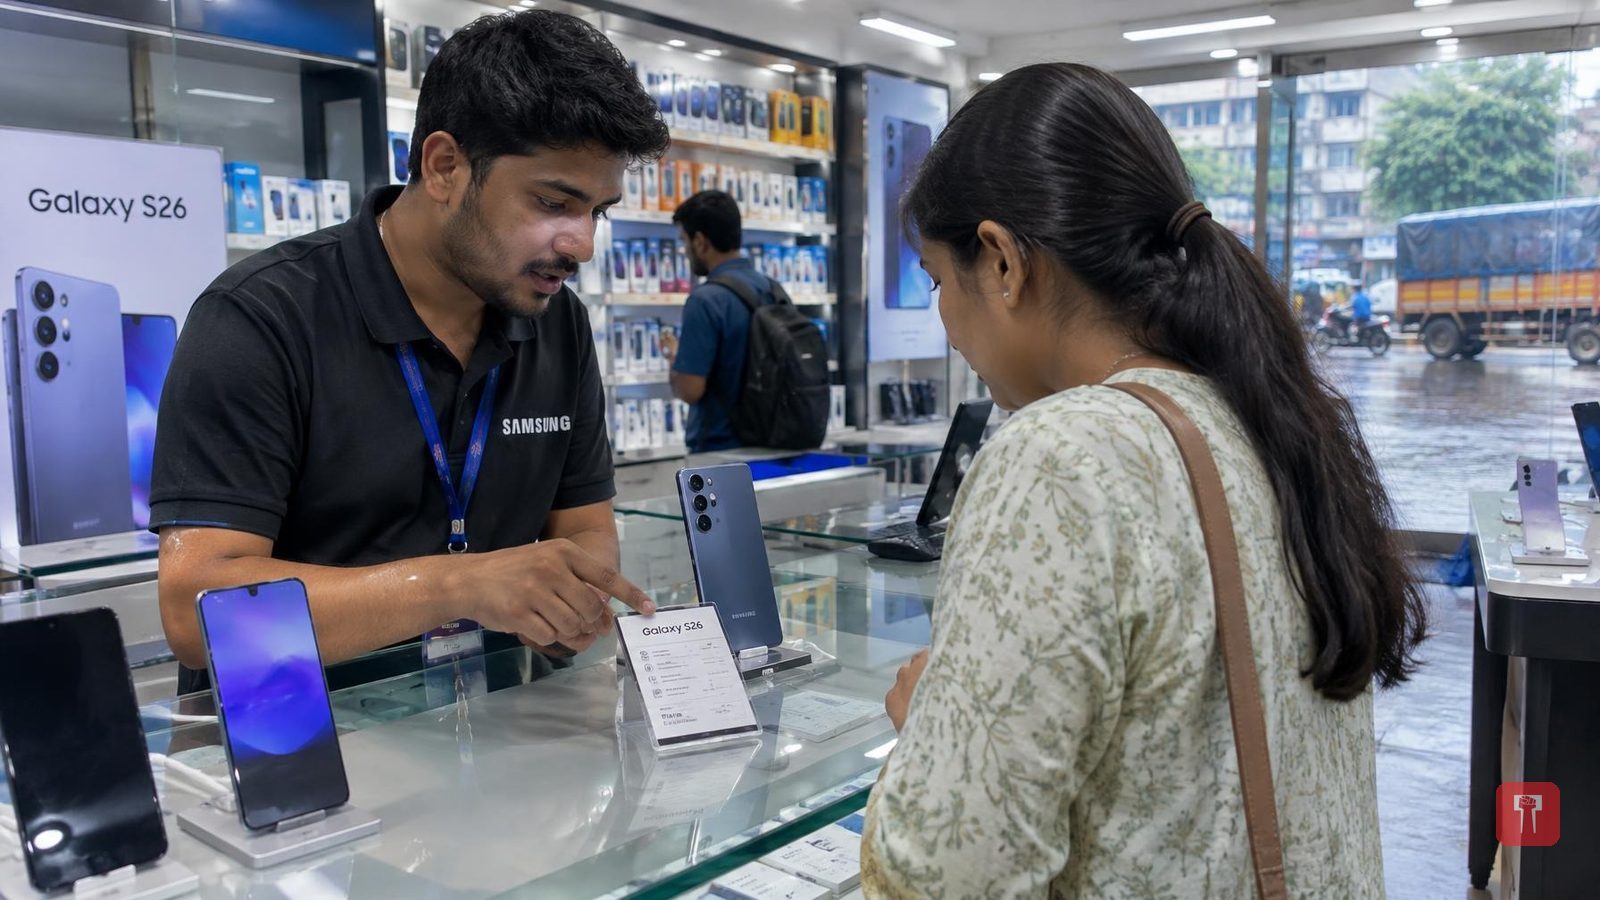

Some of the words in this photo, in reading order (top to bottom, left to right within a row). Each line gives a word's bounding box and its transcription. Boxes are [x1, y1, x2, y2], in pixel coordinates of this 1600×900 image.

[28, 187, 135, 223] Galaxy
[141, 194, 187, 220] S26
[502, 415, 571, 435] SAMSUNG
[642, 625, 682, 636] Galaxy
[683, 621, 704, 631] S26
